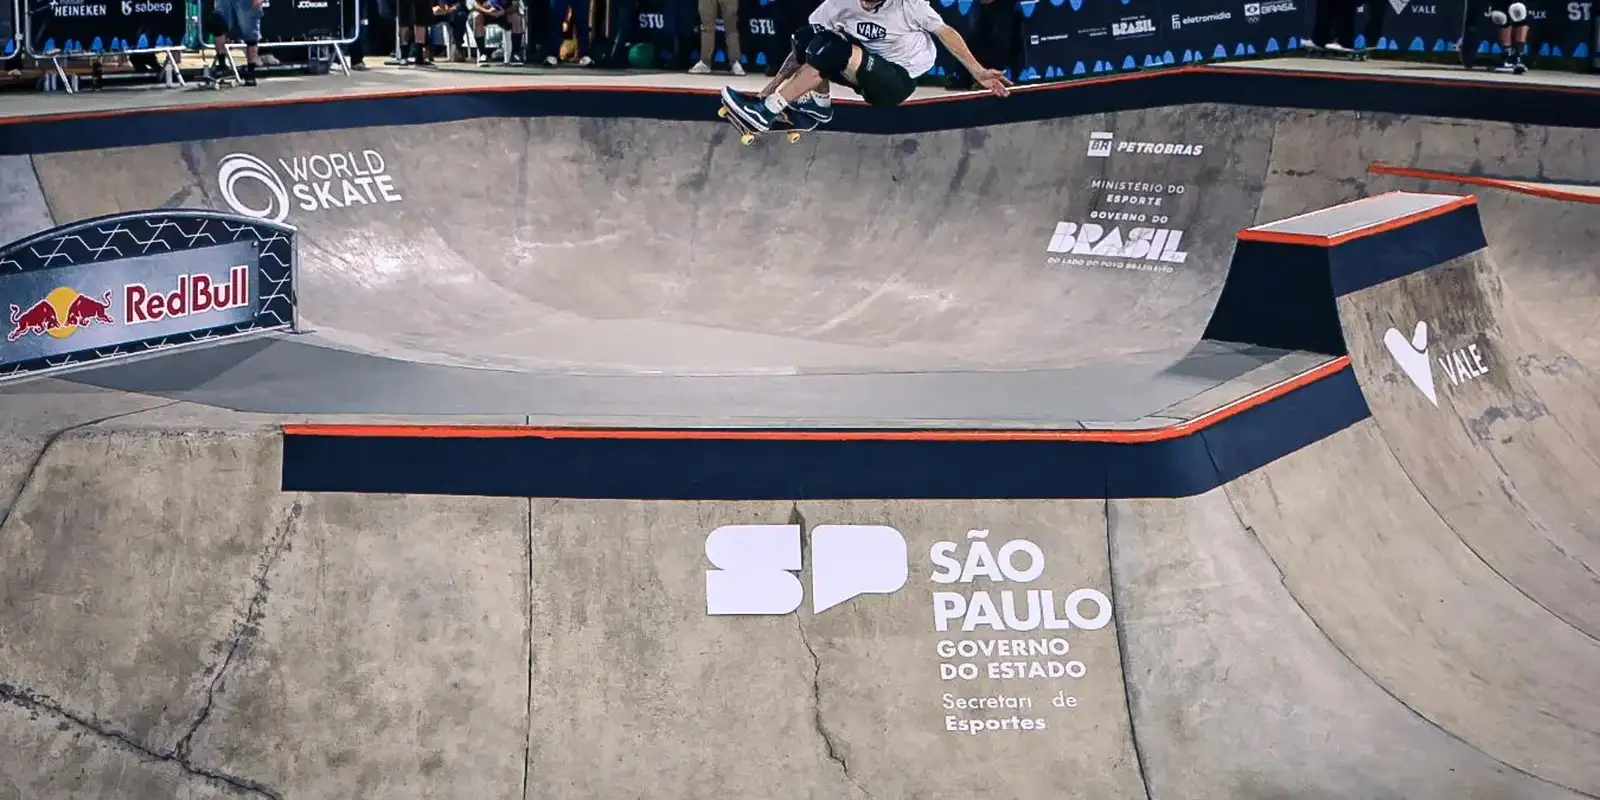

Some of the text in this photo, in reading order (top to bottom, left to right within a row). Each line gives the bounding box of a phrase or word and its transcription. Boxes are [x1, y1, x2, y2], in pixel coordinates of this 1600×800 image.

[55, 4, 106, 16] HEINEKEN
[135, 1, 173, 14] sabesp
[1411, 5, 1437, 14] VALE
[1567, 2, 1593, 21] ST
[639, 14, 664, 29] STU
[1112, 19, 1156, 36] BRASIL
[858, 23, 887, 39] VANS
[1117, 141, 1204, 156] PETROBRAS
[278, 149, 386, 182] WORLD
[292, 175, 402, 211] SKATE
[1168, 184, 1185, 194] DO
[1106, 194, 1162, 206] ESPORTE
[1090, 211, 1169, 224] GOVERNO DO
[1047, 221, 1188, 263] BRASIL
[125, 265, 248, 324] Red Bull
[1438, 343, 1489, 386] VALE
[930, 529, 1045, 584] SÃO
[932, 588, 1112, 632] PAULO
[937, 638, 1070, 658] GOVERNO
[940, 660, 1087, 680] DO ESTADO
[1052, 690, 1077, 708] de
[945, 715, 1046, 735] Esportes
